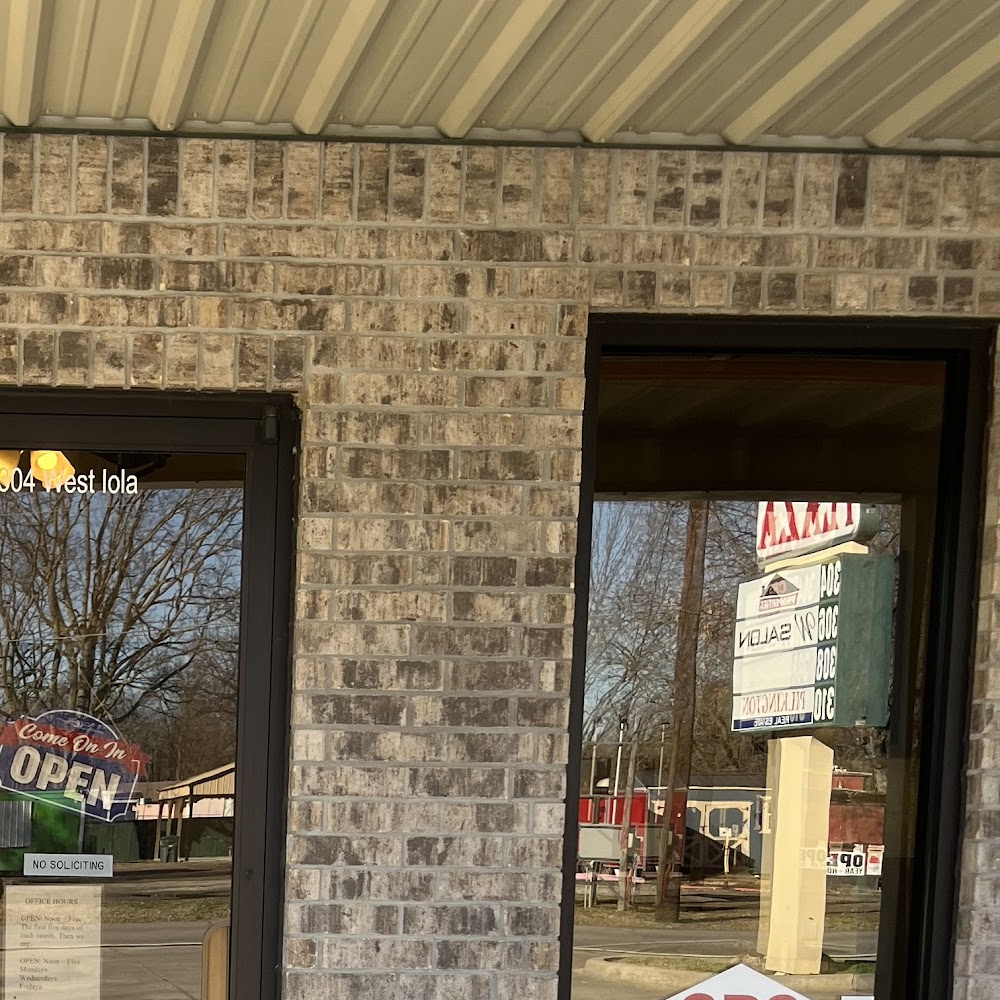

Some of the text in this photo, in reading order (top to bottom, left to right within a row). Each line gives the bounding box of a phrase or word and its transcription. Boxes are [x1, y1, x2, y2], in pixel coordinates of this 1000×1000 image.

[102, 468, 138, 494] Iola
[18, 723, 126, 760] Come On In
[10, 745, 121, 811] OPEN
[32, 860, 105, 871] NO SOLICITING
[19, 966, 47, 974] Mondays
[19, 975, 57, 983] Wednesdays
[19, 983, 42, 991] Fridays
